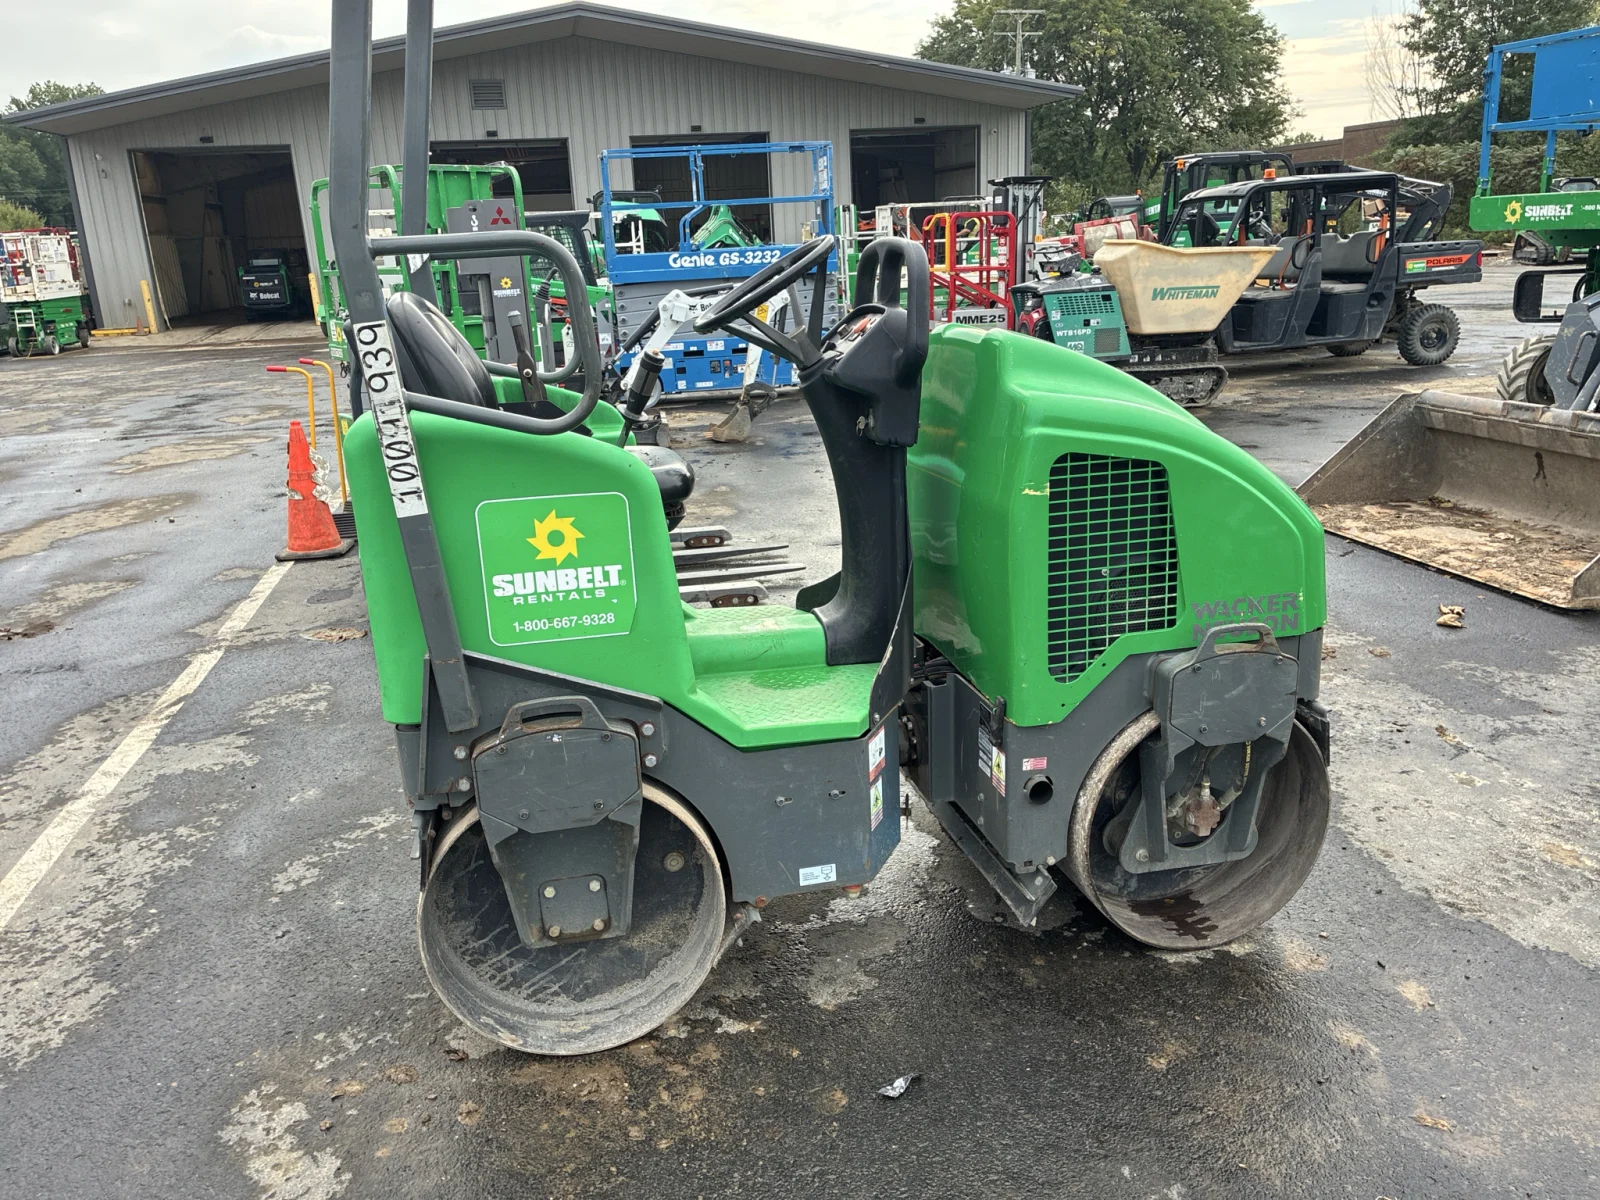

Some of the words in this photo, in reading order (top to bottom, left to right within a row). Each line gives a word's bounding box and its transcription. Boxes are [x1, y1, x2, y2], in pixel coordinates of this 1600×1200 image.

[1525, 204, 1572, 216] SUNBELT
[668, 253, 714, 268] Genie
[719, 250, 781, 266] GS-3232
[1426, 257, 1463, 265] POLARIS
[259, 292, 280, 300] Bobcat
[1151, 285, 1221, 301] WHITEMAN
[955, 314, 1006, 325] MME25
[1056, 329, 1091, 337] WTB16PD
[492, 565, 622, 597] SUNBELT
[513, 588, 606, 606] RENTALS
[1191, 593, 1299, 620] WACKER
[513, 612, 615, 632] 1-800-667-9328
